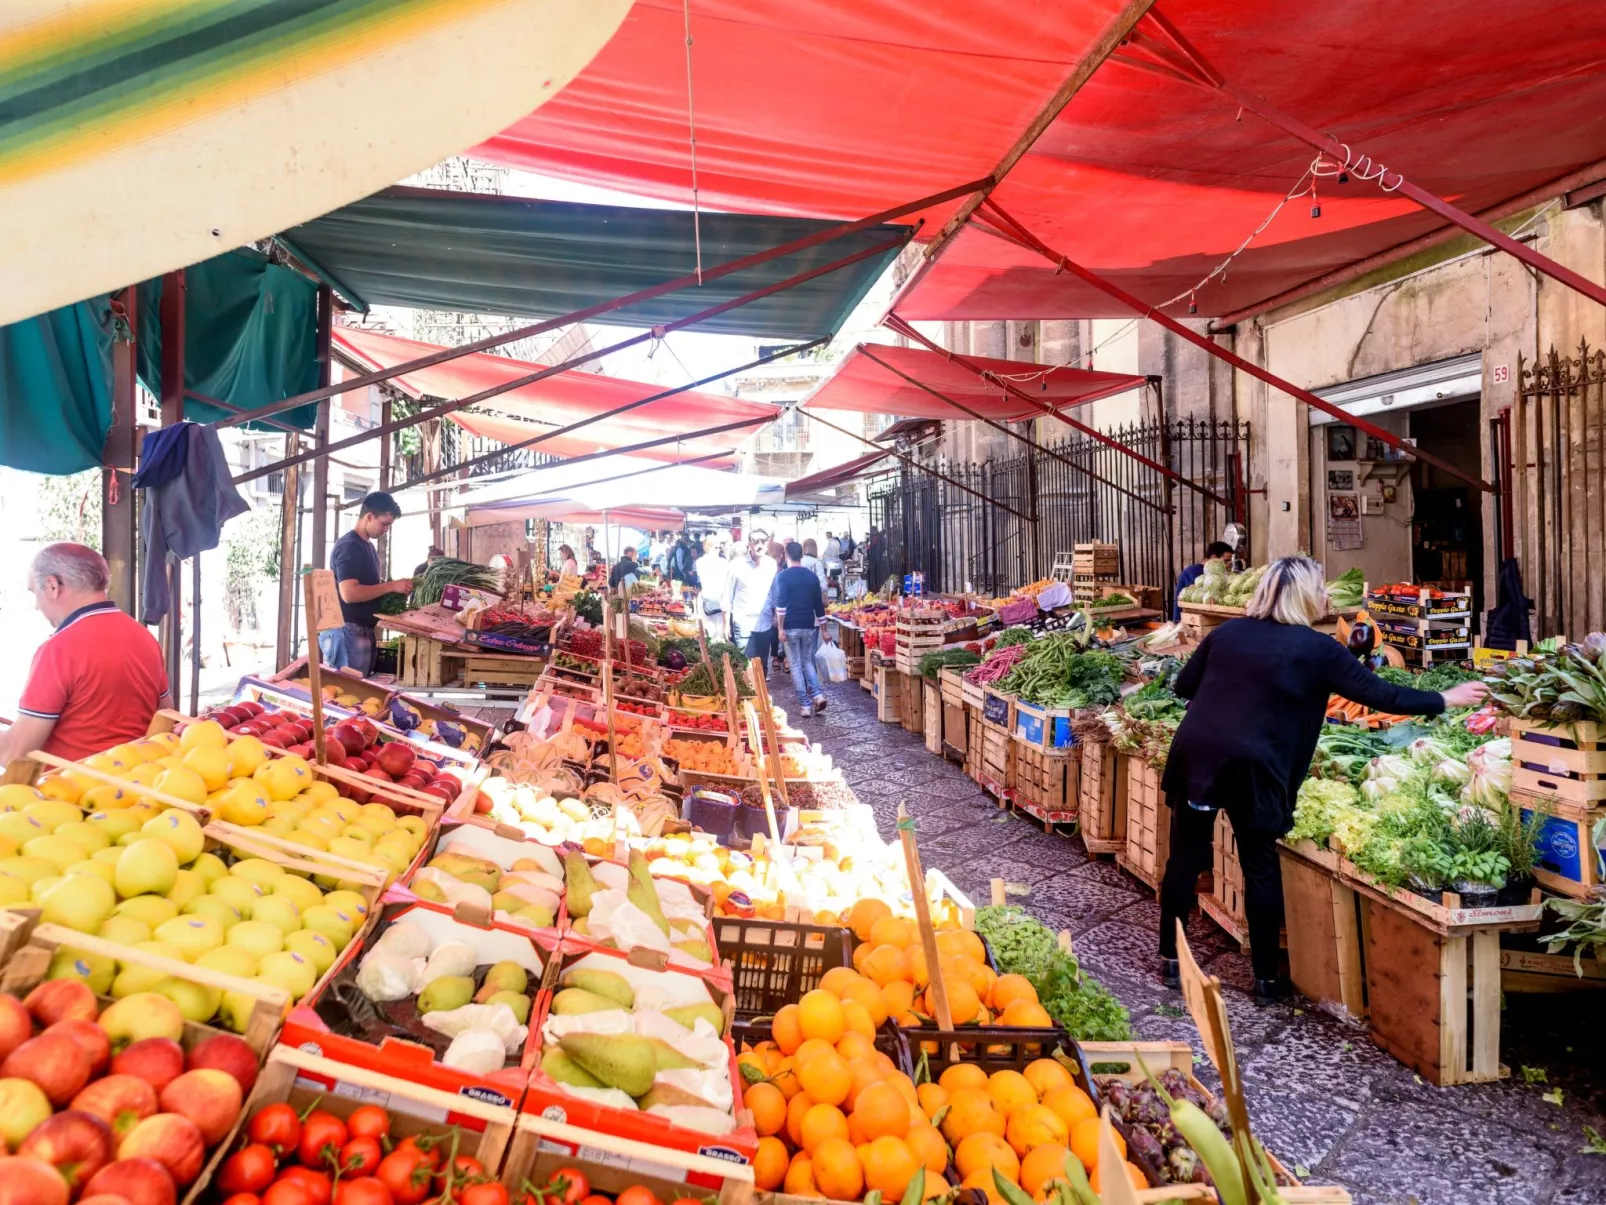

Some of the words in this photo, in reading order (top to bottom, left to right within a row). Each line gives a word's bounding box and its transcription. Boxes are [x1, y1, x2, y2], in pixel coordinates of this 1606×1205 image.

[1495, 366, 1508, 382] 59
[1368, 600, 1387, 612] Doppio
[1388, 604, 1405, 614] Gusto
[1430, 606, 1449, 614] Doppio
[479, 634, 505, 646] Extra
[1388, 633, 1405, 643] Gusto
[1428, 637, 1448, 645] Doppio
[1449, 635, 1467, 644] Gusto
